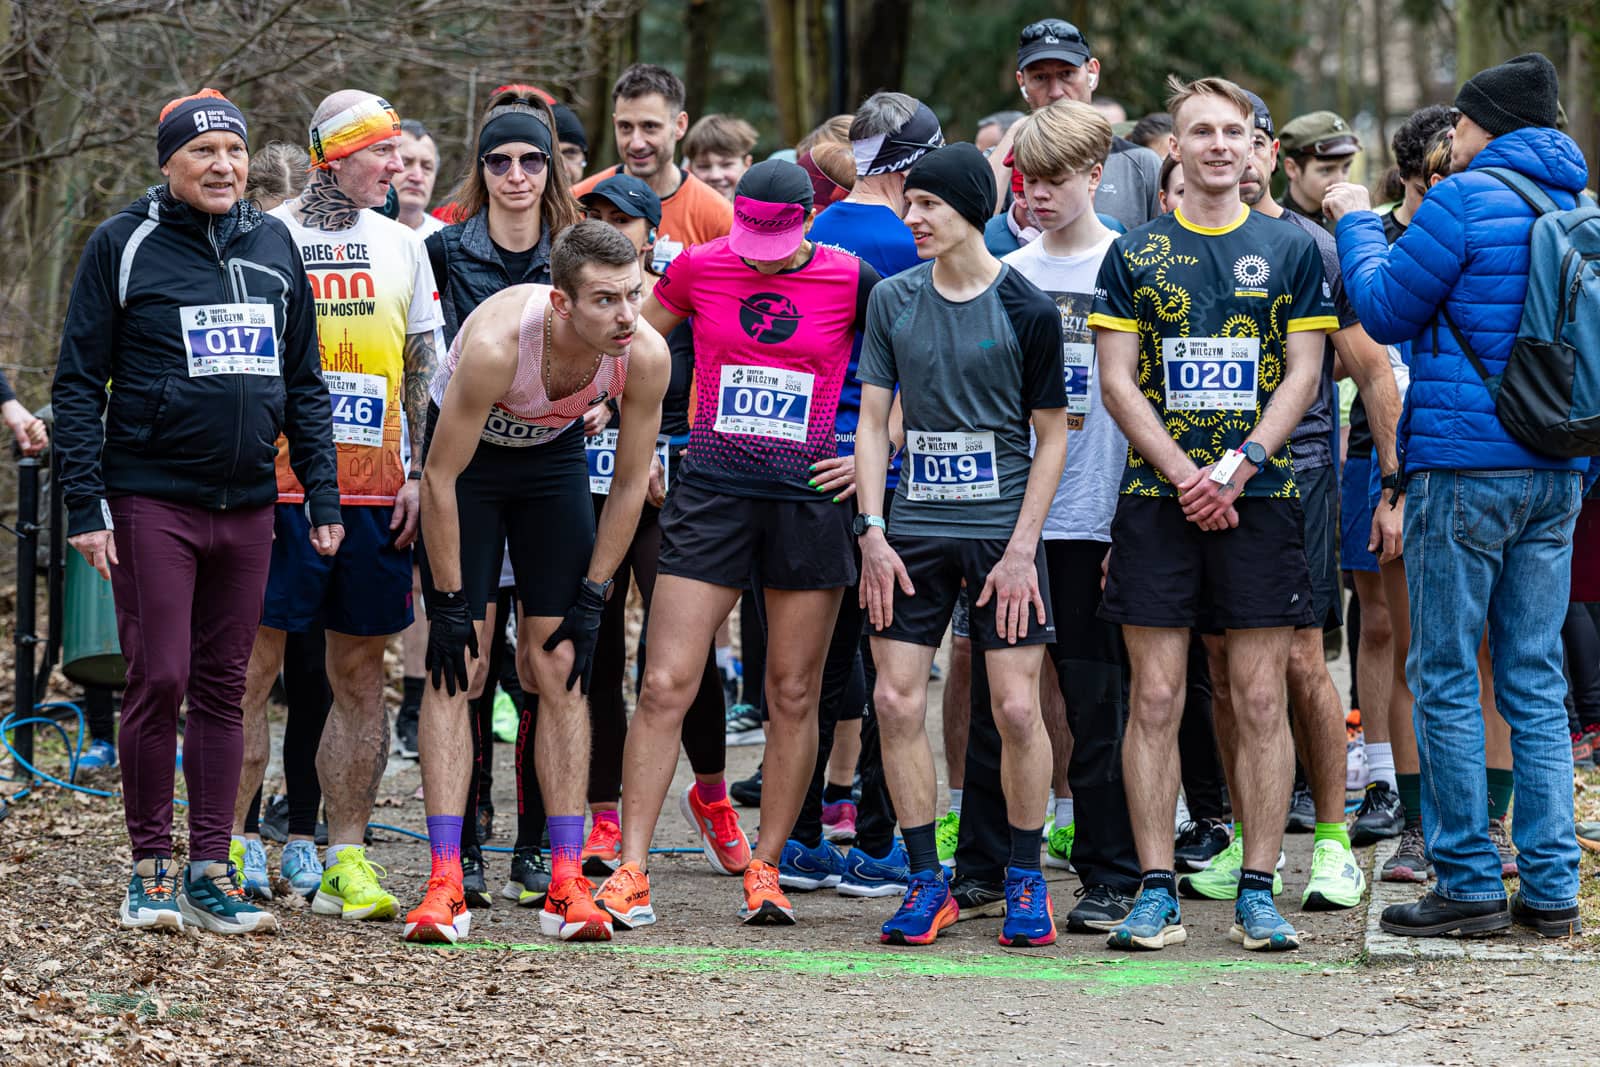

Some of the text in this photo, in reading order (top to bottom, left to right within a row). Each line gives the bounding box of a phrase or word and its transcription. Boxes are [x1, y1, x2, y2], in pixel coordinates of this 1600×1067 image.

[193, 110, 209, 132] 9
[316, 299, 376, 317] TU MOSTÓW
[210, 313, 244, 324] WILCZYM
[205, 328, 261, 354] 017
[1190, 347, 1224, 356] WILCZYM
[746, 374, 779, 386] WILCZYM
[1180, 362, 1242, 389] 020
[785, 383, 802, 392] 2026
[332, 396, 373, 424] 46
[734, 388, 797, 418] 007
[928, 441, 958, 451] WILCZYM
[965, 444, 983, 452] 2026
[924, 455, 978, 482] 019
